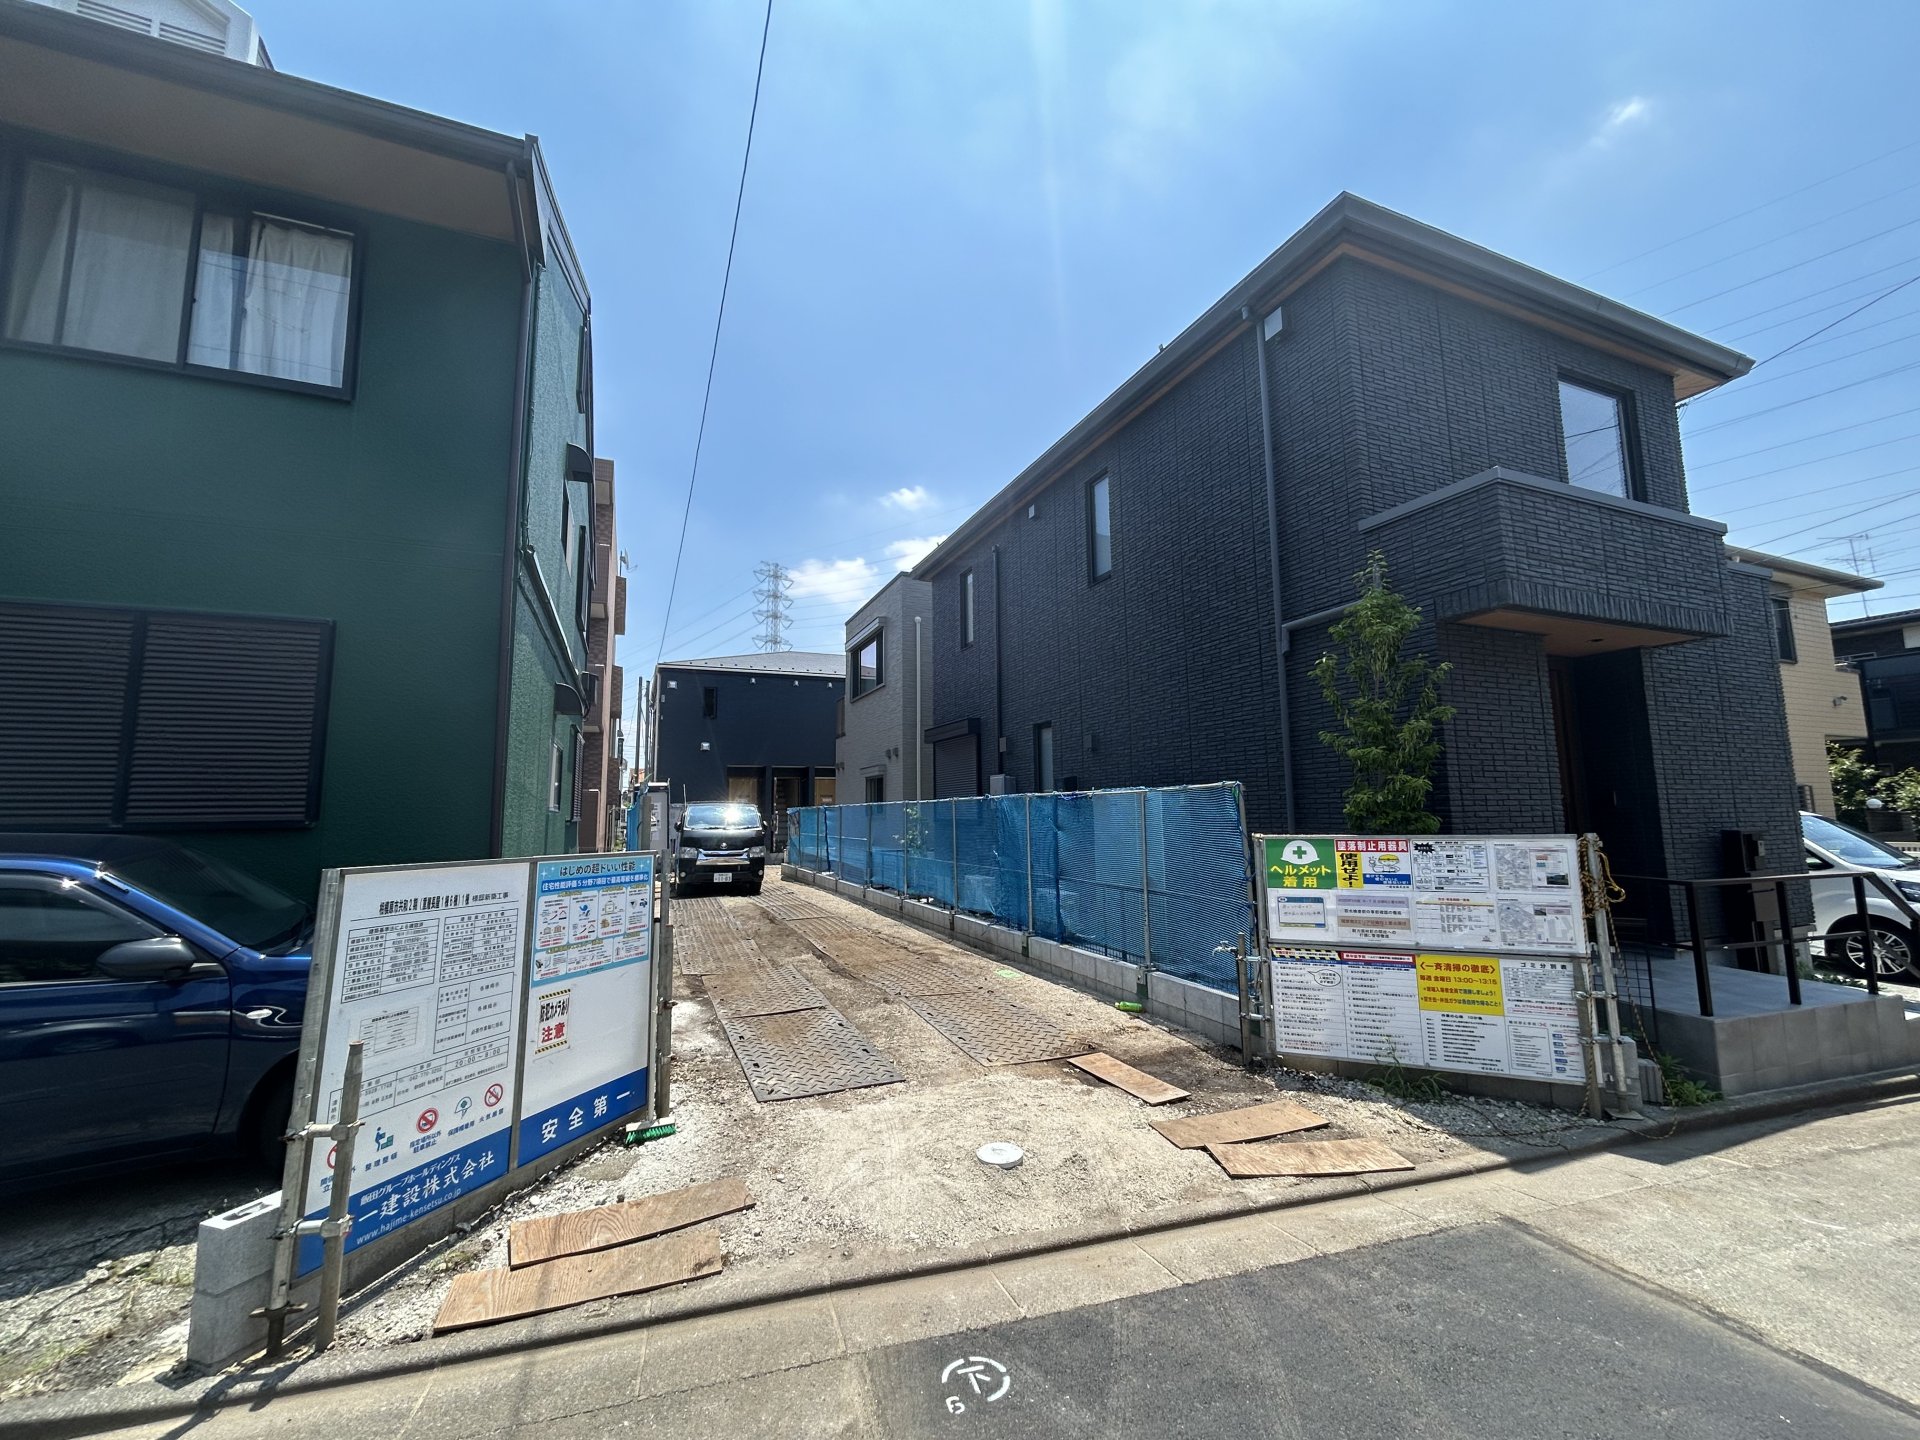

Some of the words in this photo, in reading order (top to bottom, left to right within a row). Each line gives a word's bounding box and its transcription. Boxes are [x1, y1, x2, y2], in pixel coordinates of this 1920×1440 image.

[560, 861, 636, 877] はじめの超ドいい性能
[1270, 864, 1331, 877] ヘルメット
[1283, 876, 1318, 888] 着用
[1433, 975, 1452, 983] 金曜日
[541, 1022, 566, 1044] 注意
[541, 1090, 631, 1144] 安全第一
[358, 1150, 494, 1222] 一建設株式会社
[360, 1153, 461, 1207] 飯田グループホールディングス
[356, 1187, 462, 1246] www.hajime-kensetsu.co.jp
